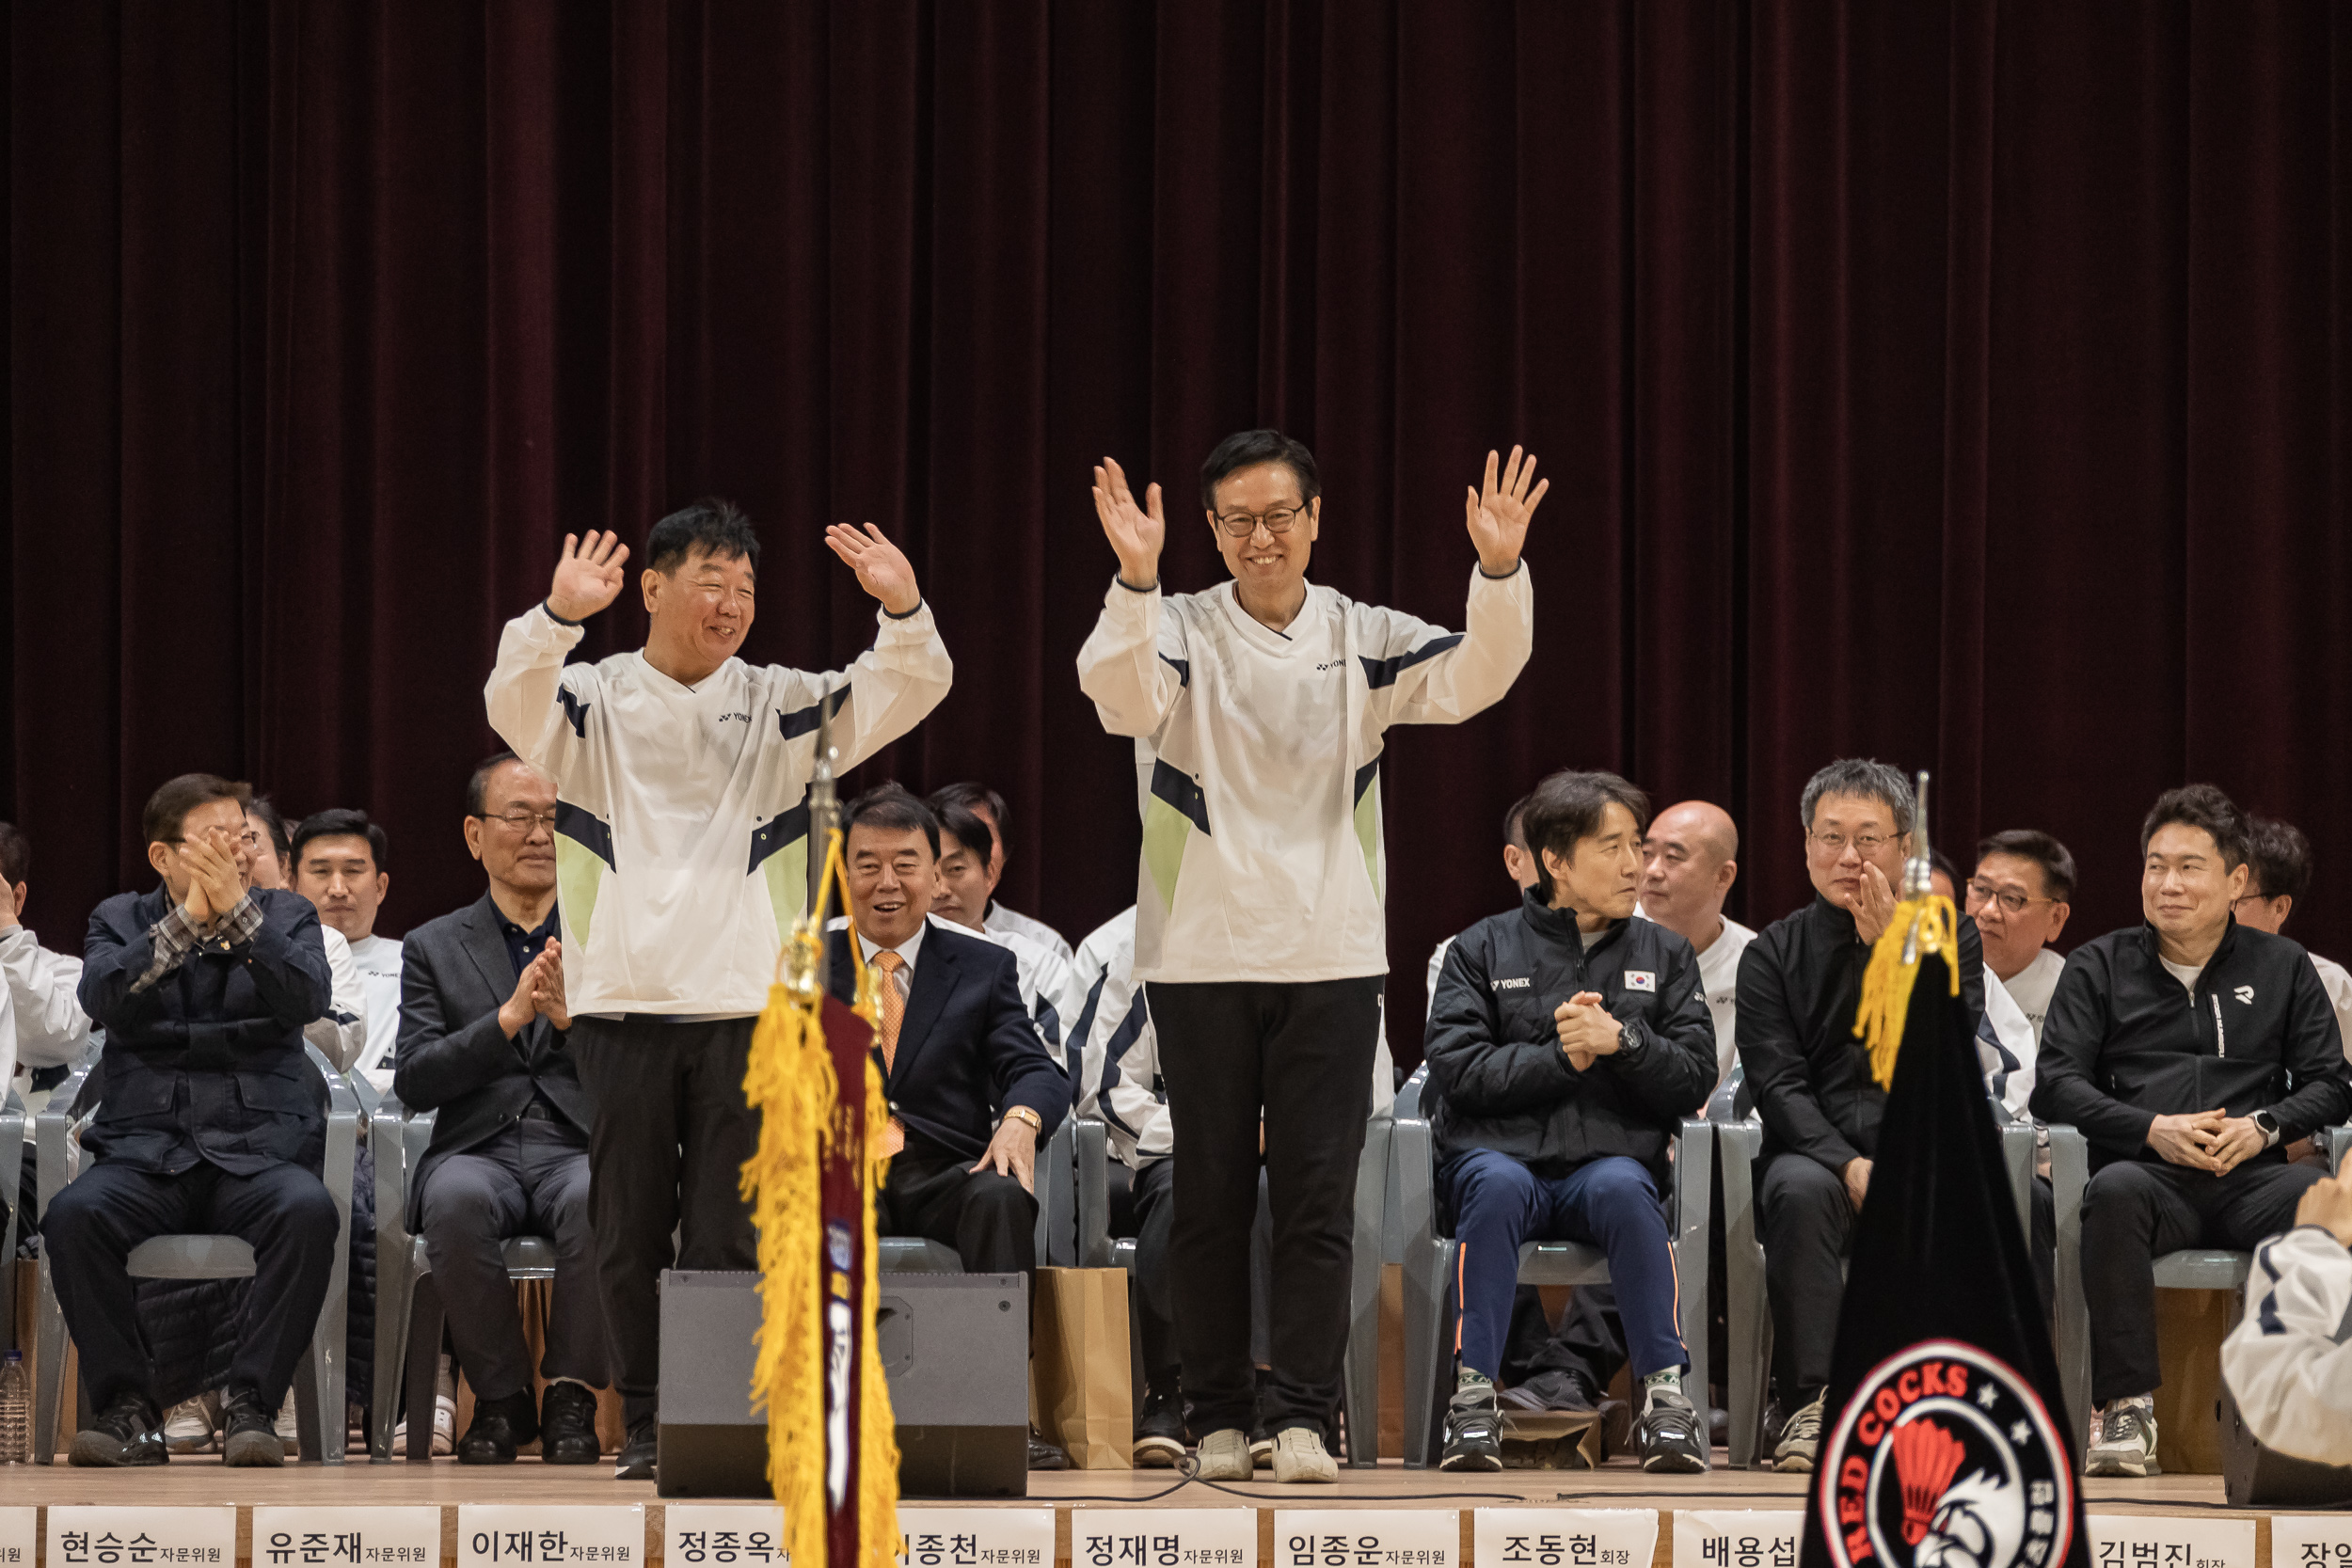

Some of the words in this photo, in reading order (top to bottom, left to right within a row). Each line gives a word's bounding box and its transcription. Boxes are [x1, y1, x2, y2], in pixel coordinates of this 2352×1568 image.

[734, 712, 752, 723] YONEX
[1501, 977, 1530, 990] YONEX
[1840, 1455, 1874, 1564] RED
[1857, 1362, 1969, 1447] COCKS
[61, 1531, 157, 1563] 현승순
[160, 1547, 221, 1562] 자문위원
[266, 1532, 361, 1563] 유준재
[366, 1546, 426, 1562] 자문위원
[472, 1530, 568, 1562] 이재한
[570, 1545, 630, 1561] 자문위원
[678, 1531, 774, 1563] 정종옥
[980, 1549, 1041, 1564] 자문위원
[1086, 1535, 1180, 1566] 정재명
[1184, 1549, 1244, 1564] 자문위원
[1289, 1535, 1383, 1566] 임종운
[1386, 1550, 1445, 1565] 자문위원
[1502, 1534, 1597, 1566] 조동현
[1599, 1549, 1630, 1565] 회장
[1702, 1536, 1795, 1568] 배용섭
[2099, 1541, 2191, 1568] 김범진
